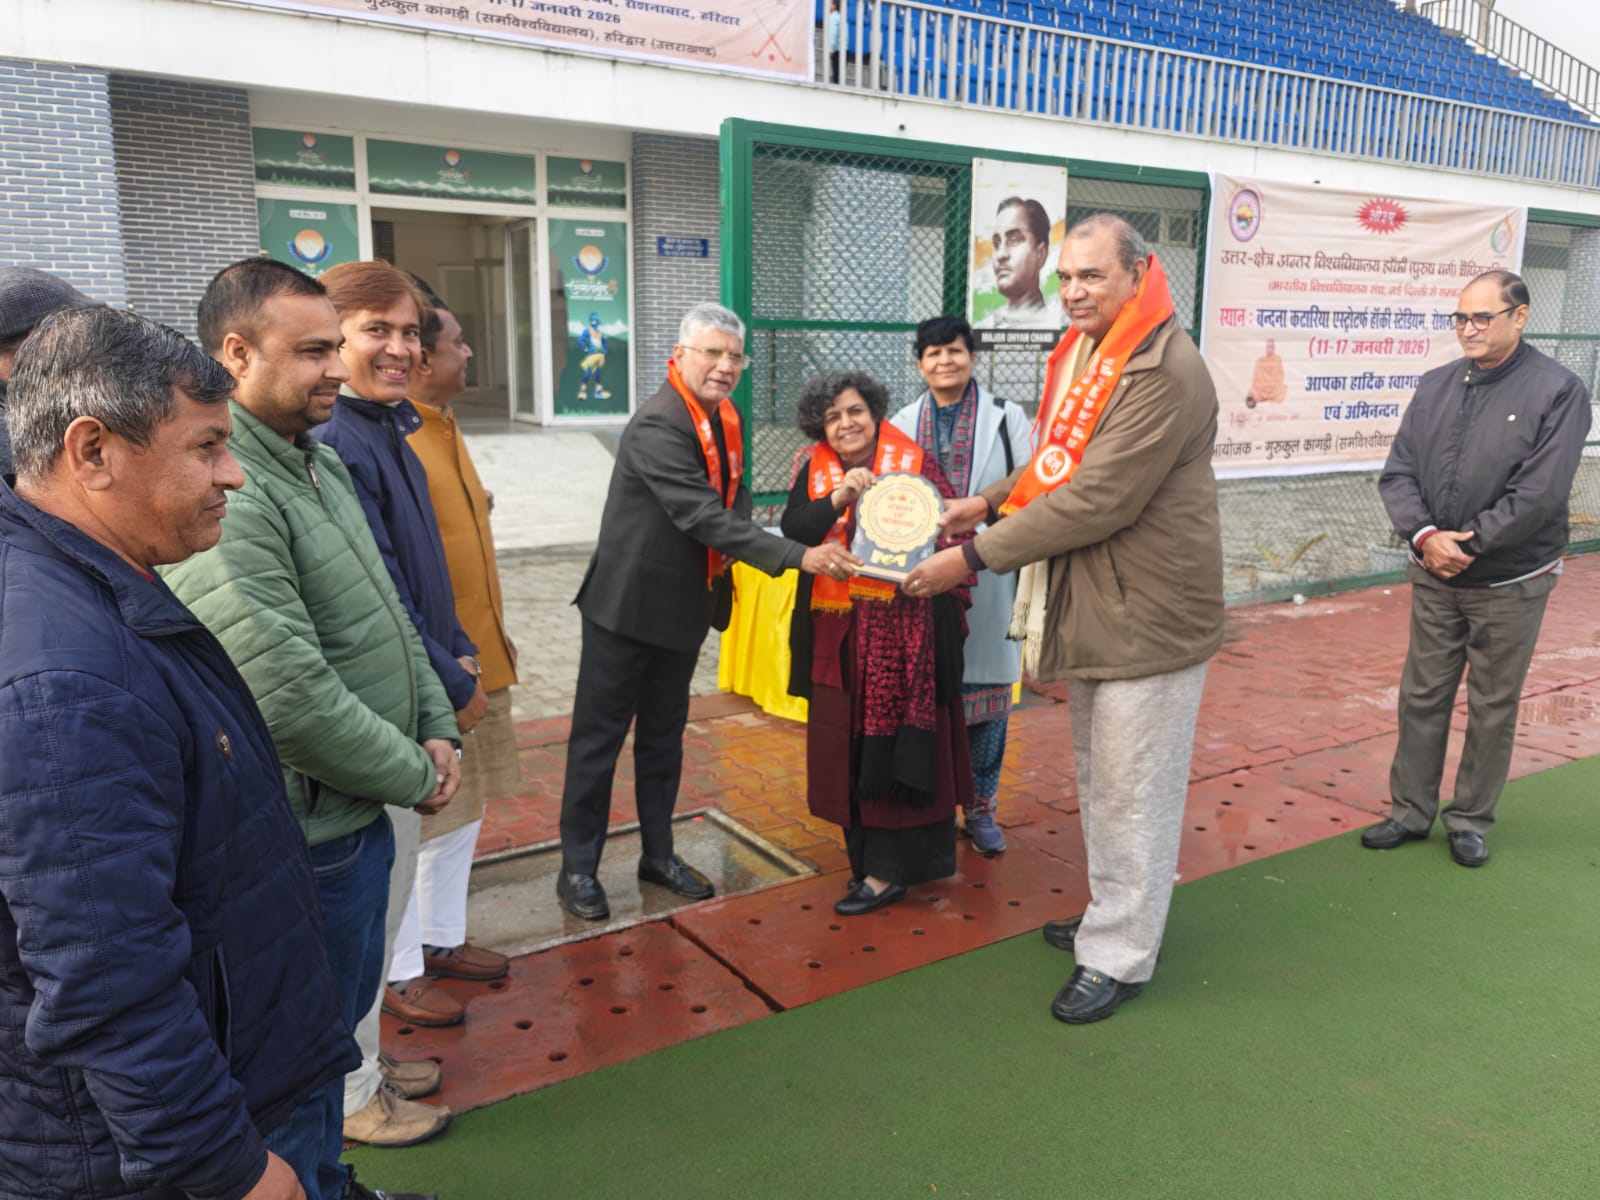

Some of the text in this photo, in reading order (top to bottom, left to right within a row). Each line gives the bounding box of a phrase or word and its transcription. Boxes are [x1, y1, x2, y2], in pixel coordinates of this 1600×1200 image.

[531, 1, 582, 18] जनवरी
[587, 10, 622, 23] 2026
[604, 30, 646, 47] हरिद्वार
[1290, 304, 1330, 329] कटारिया
[1370, 306, 1392, 329] हॉकी
[1308, 336, 1431, 359] (11-17 जनवरी 2026)
[1305, 375, 1347, 391] आपका
[1350, 371, 1386, 390] हार्दिक
[1323, 400, 1343, 420] एवं
[1344, 400, 1399, 420] अभिनन्दन
[1265, 439, 1300, 460] गुरुकुल
